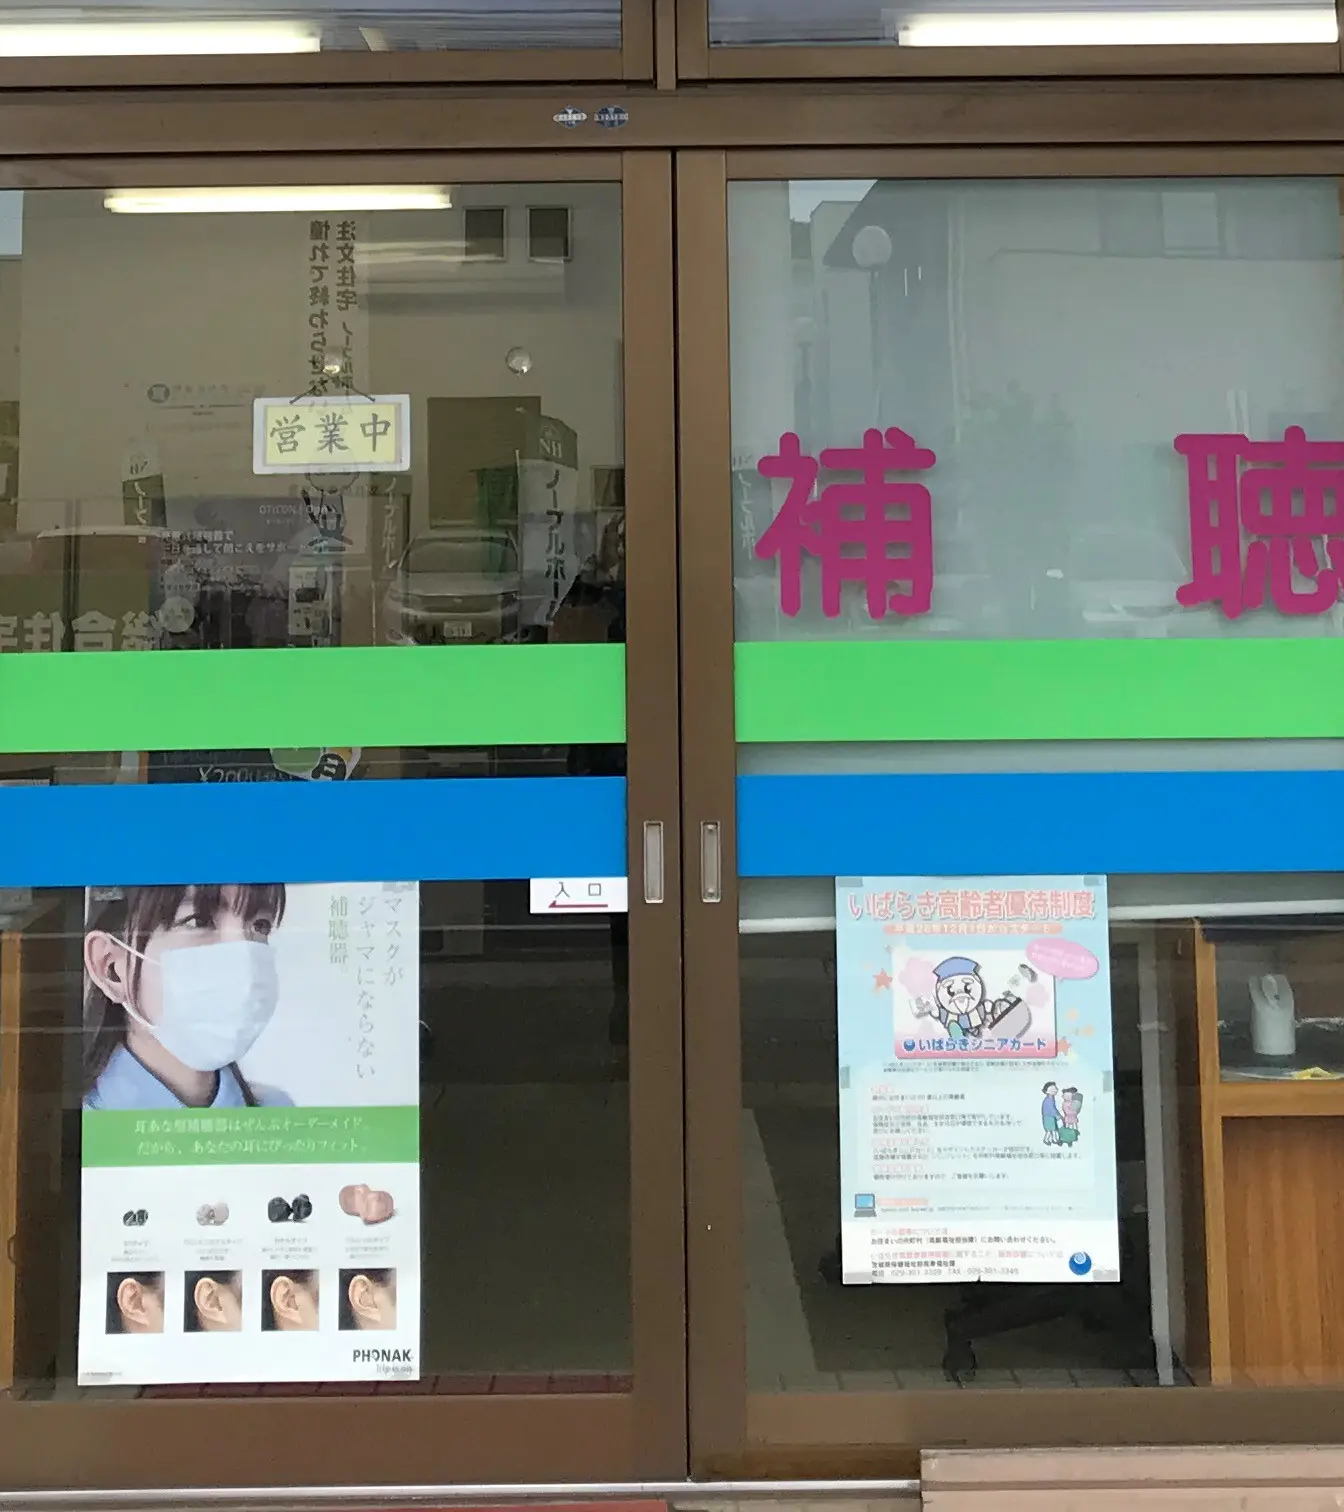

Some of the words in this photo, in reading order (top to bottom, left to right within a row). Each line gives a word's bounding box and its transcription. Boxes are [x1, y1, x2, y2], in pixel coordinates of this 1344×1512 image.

[269, 412, 393, 455] 営業中
[555, 881, 602, 898] 入口
[384, 896, 404, 986] マスクが
[352, 1348, 412, 1362] PHONAK
